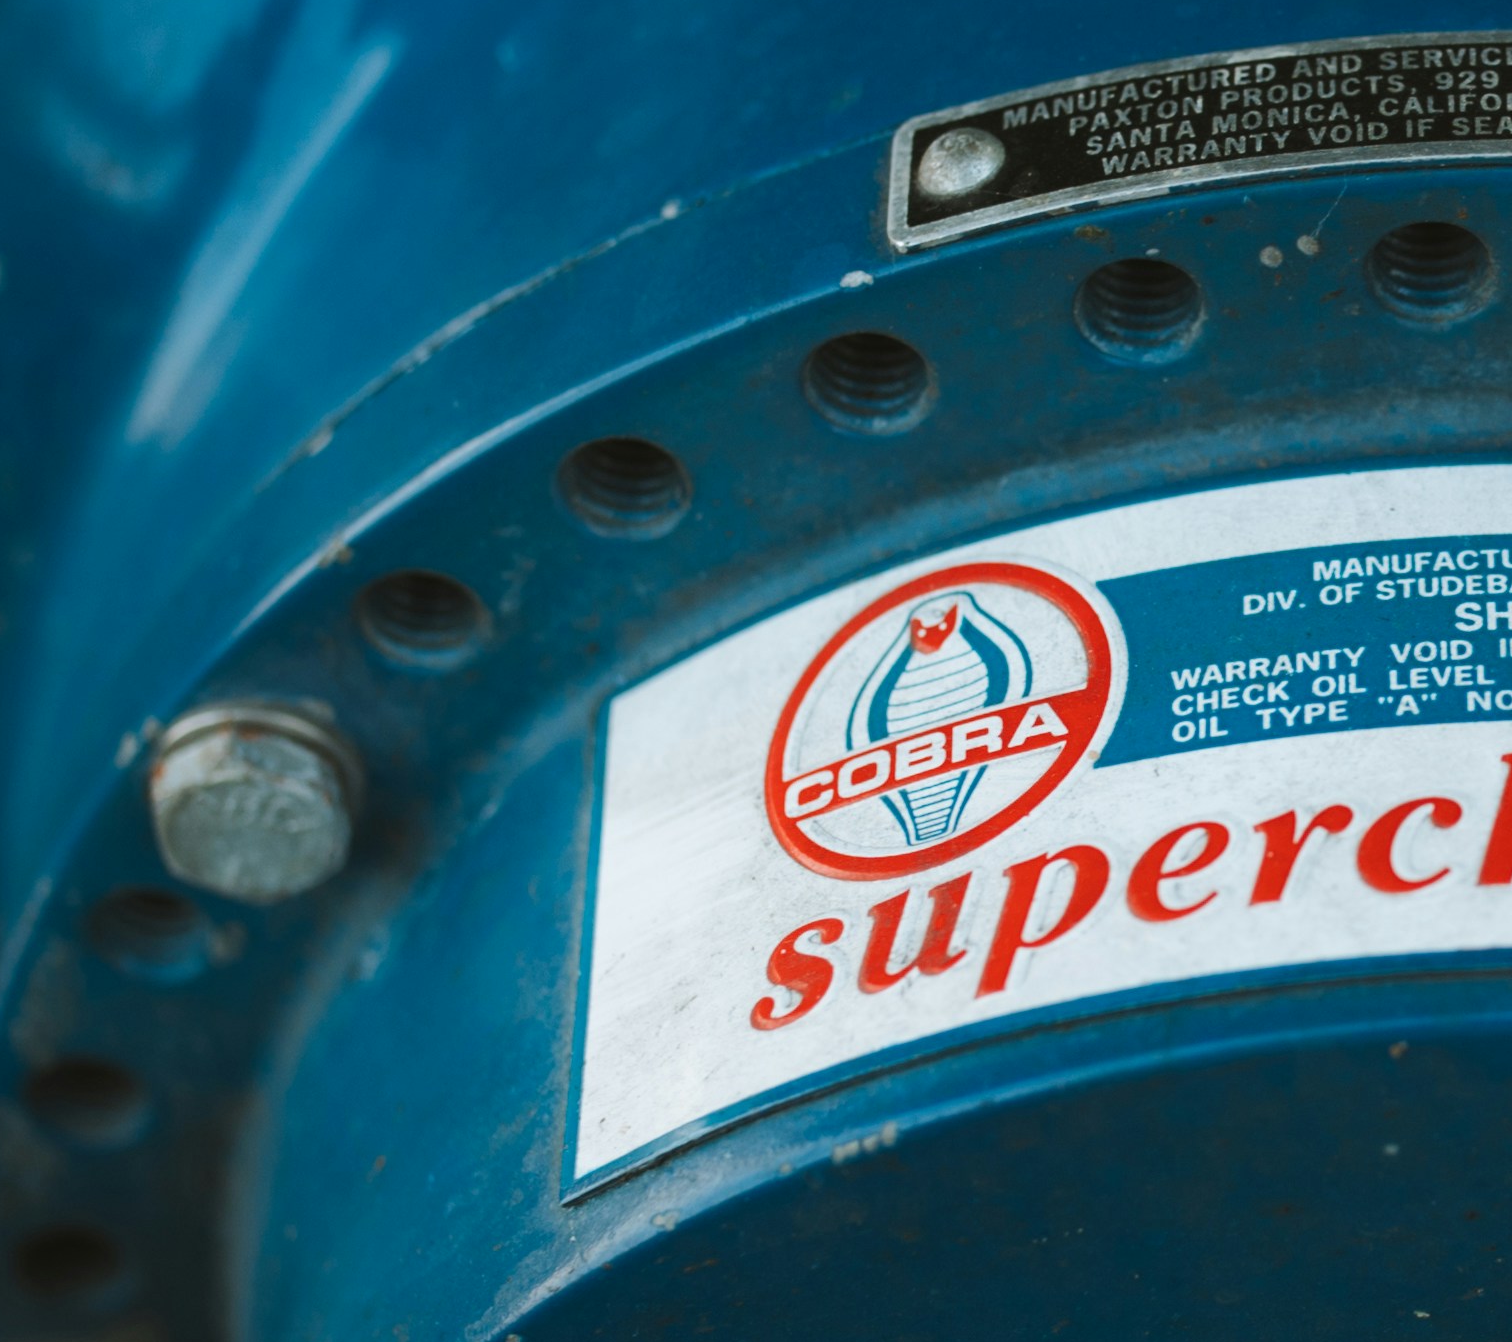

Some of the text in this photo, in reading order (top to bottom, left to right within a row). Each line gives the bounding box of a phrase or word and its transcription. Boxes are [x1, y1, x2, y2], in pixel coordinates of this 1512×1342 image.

[1004, 63, 1276, 129] MANUFACTURED
[1292, 55, 1361, 78] AND
[1069, 95, 1203, 136] PAXTON
[1221, 75, 1416, 110] PRODUCTS,
[1435, 70, 1499, 90] 929
[1086, 120, 1195, 155] SANTA
[1212, 103, 1360, 135] MONICA,
[1102, 130, 1290, 175] WARRANTY
[1308, 122, 1388, 145] VOID
[1407, 119, 1434, 137] IF
[1243, 590, 1305, 615] DIV.
[1319, 582, 1363, 605] OF
[1171, 647, 1364, 690] WARRANTY
[1390, 640, 1472, 663] VOID
[1172, 681, 1289, 716] CHECK
[1312, 673, 1366, 697] OIL
[1389, 665, 1495, 690] LEVEL
[1172, 716, 1228, 742] OIL
[1256, 700, 1348, 729] TYPE
[784, 703, 1069, 818] COBRA
